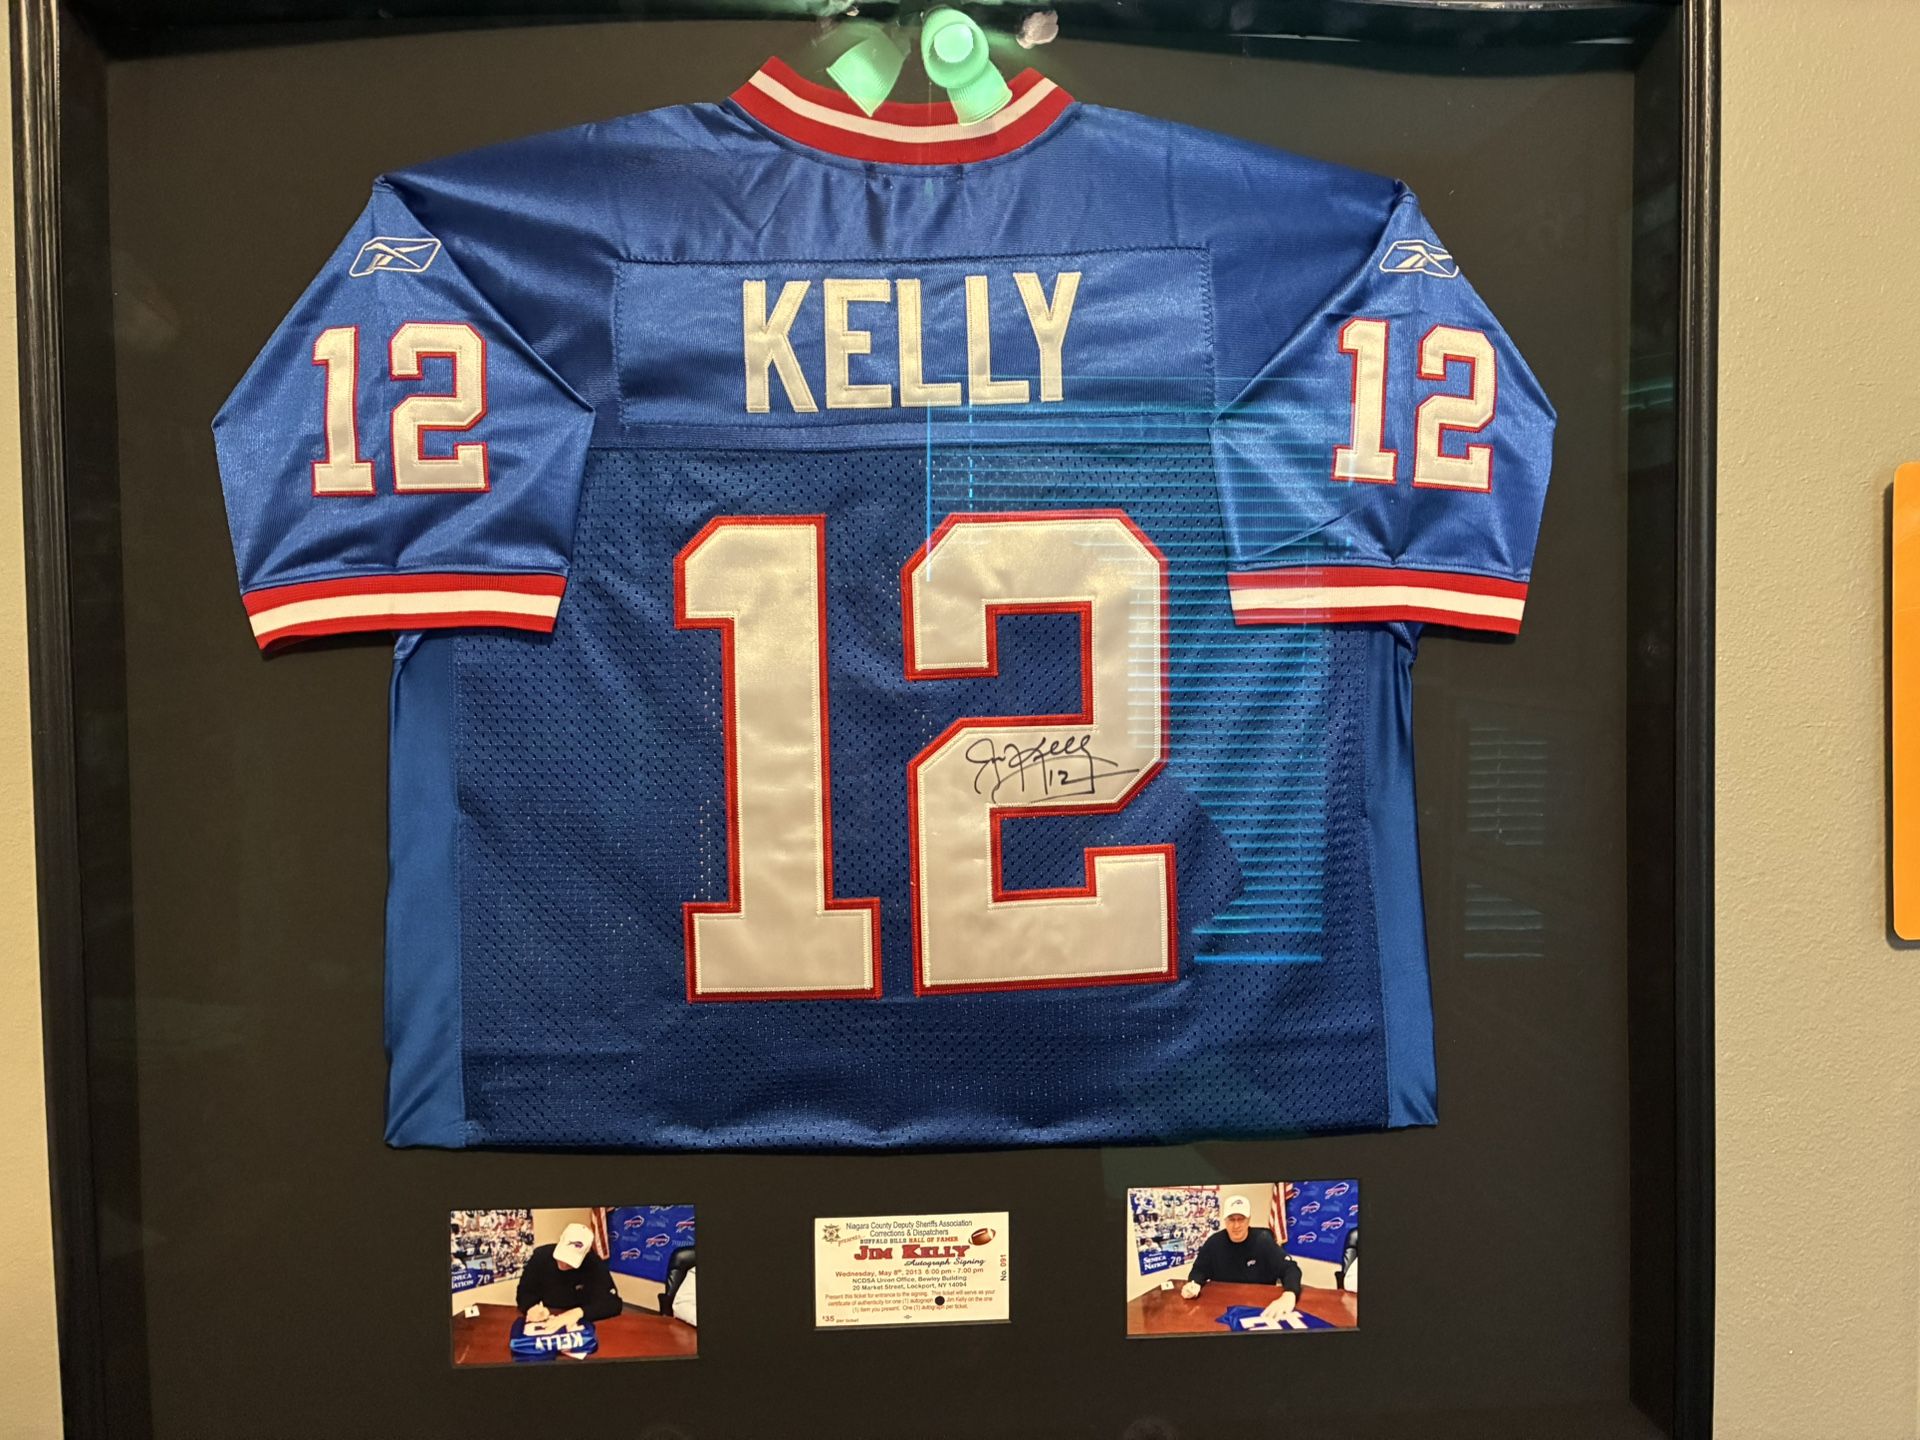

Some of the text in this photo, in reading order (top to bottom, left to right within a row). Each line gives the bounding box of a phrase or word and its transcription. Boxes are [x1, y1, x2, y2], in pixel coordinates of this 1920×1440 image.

[743, 272, 1082, 413] KELLY
[311, 320, 491, 496] 12
[1331, 317, 1497, 494] 12
[674, 508, 1178, 1003] 12
[846, 1222, 869, 1231] Niagara
[871, 1221, 892, 1230] County
[893, 1220, 914, 1230] Deputy
[939, 1219, 972, 1228] Association
[913, 1228, 948, 1237] Dispatchers
[854, 1244, 970, 1260] JIM KELLY
[904, 1257, 984, 1268] Autograph Signing
[535, 1332, 584, 1351] KELLY
